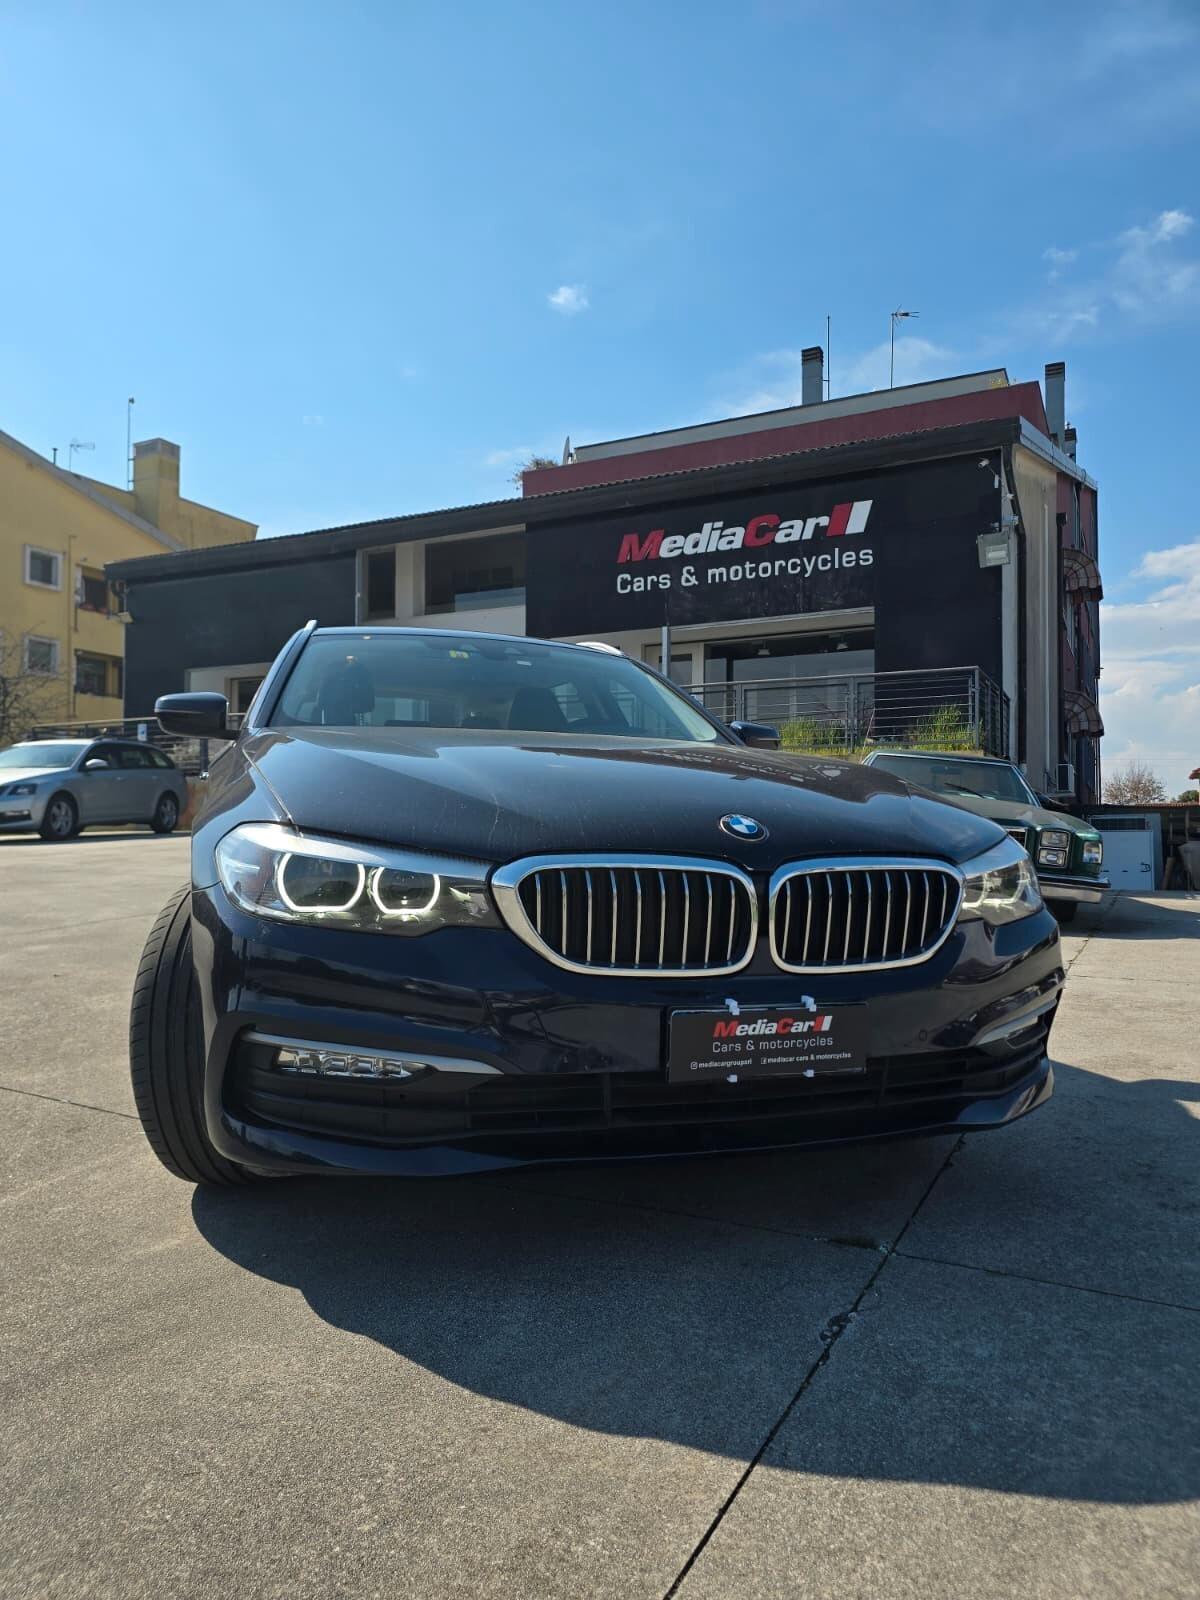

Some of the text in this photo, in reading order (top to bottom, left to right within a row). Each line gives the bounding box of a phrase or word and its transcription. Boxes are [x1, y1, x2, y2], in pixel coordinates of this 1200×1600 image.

[616, 547, 875, 595] Cars & motorcycles
[712, 1036, 834, 1053] Cars & motorcycles
